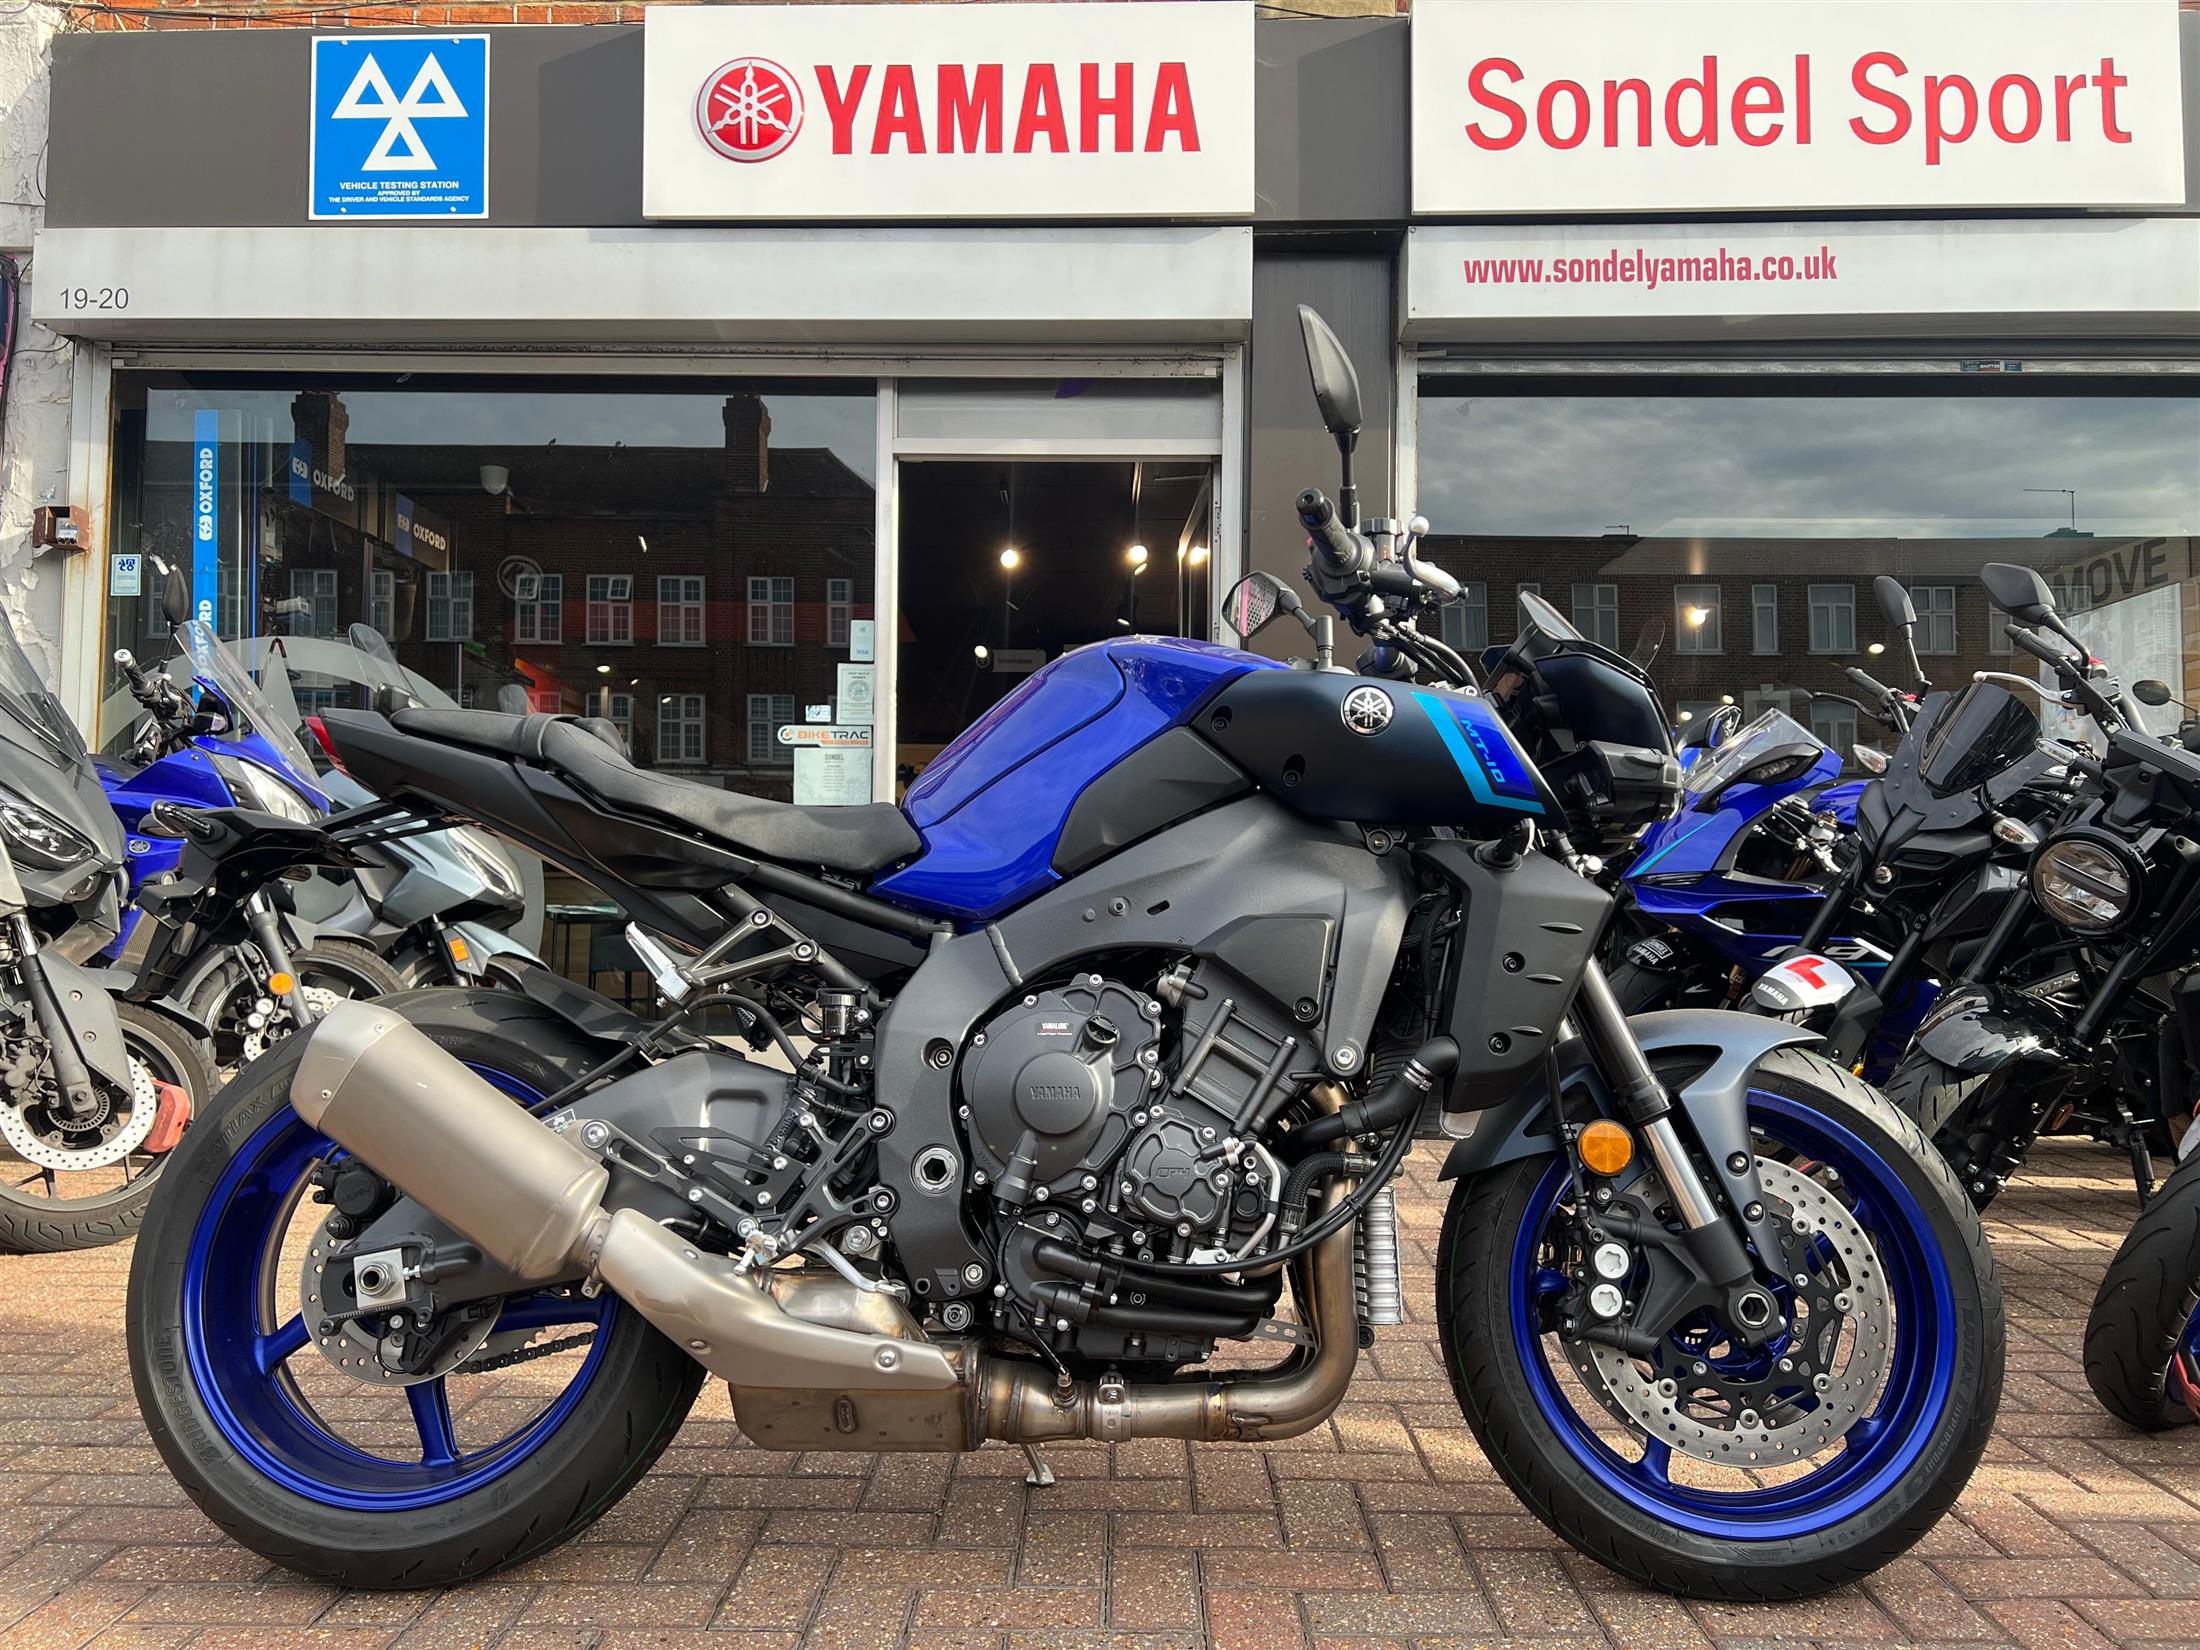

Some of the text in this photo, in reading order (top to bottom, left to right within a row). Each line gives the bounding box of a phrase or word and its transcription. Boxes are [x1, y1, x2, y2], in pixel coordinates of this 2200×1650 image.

[813, 62, 1202, 156] YAMAHA
[1464, 50, 2133, 166] Sondel Sport
[339, 181, 459, 190] VEHICLE TESTING STATION
[1464, 246, 1838, 290] www.sondelyamaha.co.uk
[58, 287, 130, 311] 19-20
[199, 447, 213, 513] OXFORD
[313, 469, 355, 502] OXFORD
[413, 521, 446, 551] OXFORD
[2053, 537, 2169, 612] MOVE
[798, 730, 869, 740] BIKETRAC
[1757, 982, 1789, 1006] YAMAHA
[1030, 1086, 1081, 1100] YAMAHA
[156, 1333, 222, 1466] BRIDGESTONE
